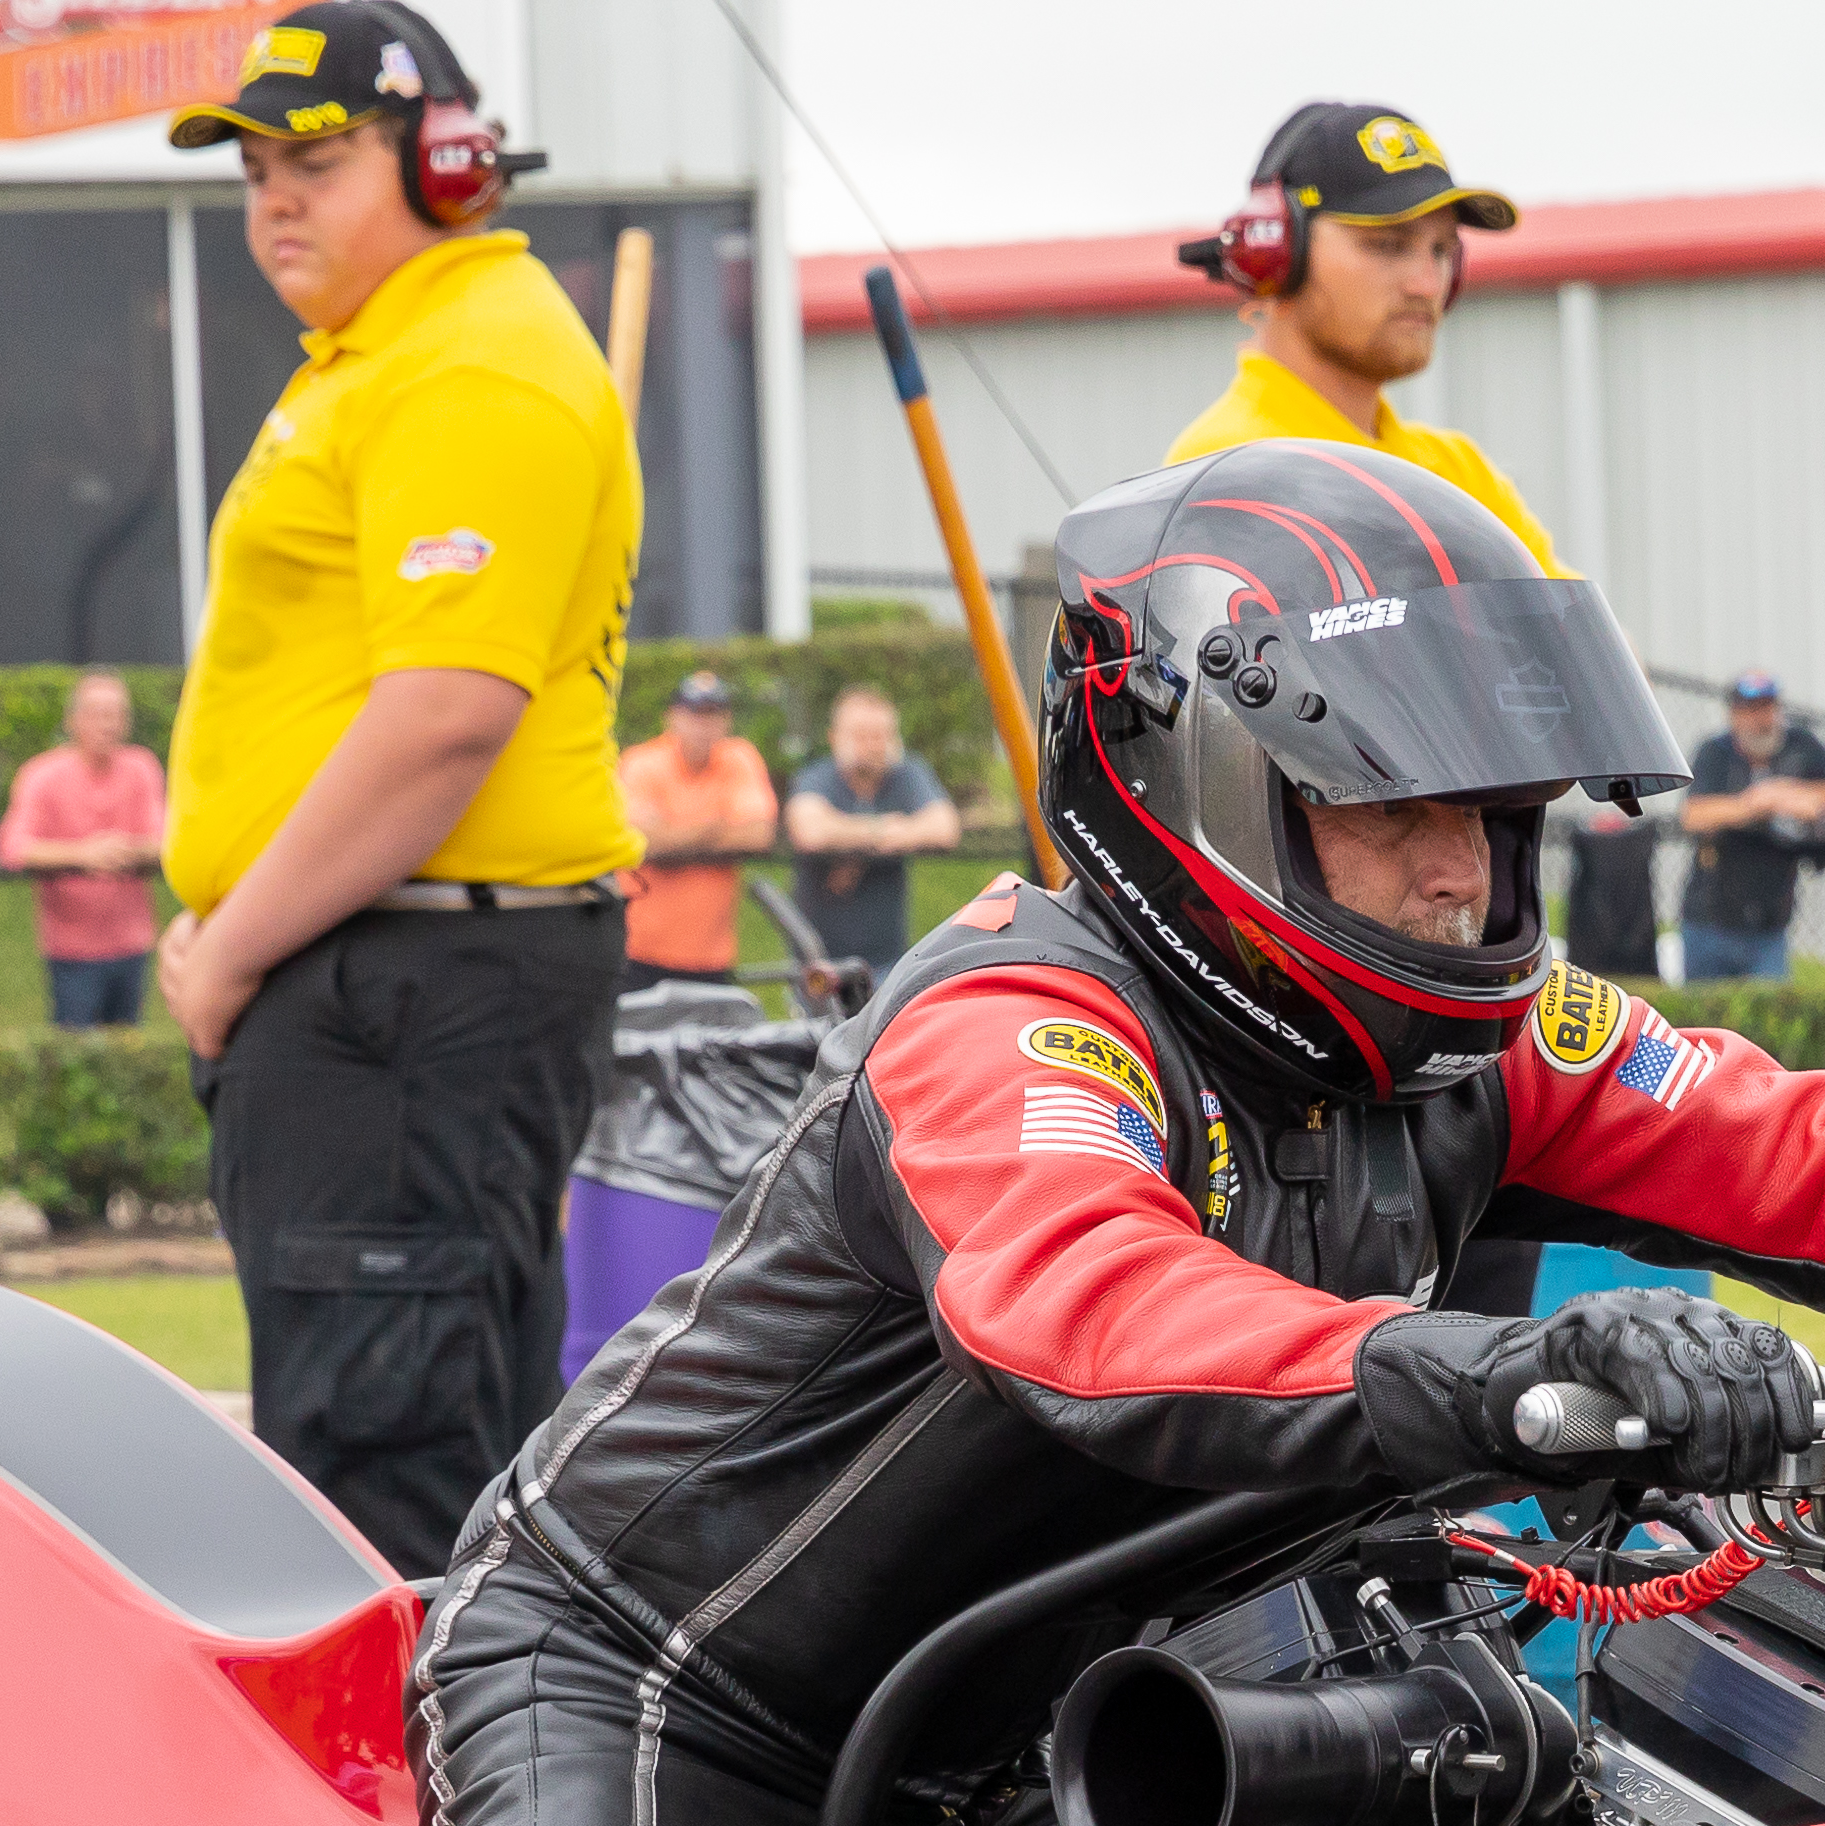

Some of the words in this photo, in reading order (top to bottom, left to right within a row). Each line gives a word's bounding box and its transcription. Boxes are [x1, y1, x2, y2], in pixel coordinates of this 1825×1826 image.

[22, 22, 244, 126] EXPRES
[1308, 597, 1408, 629] VANCE
[1309, 610, 1407, 642] HINES
[1062, 809, 1329, 1061] HARLEY-DAVIDSON
